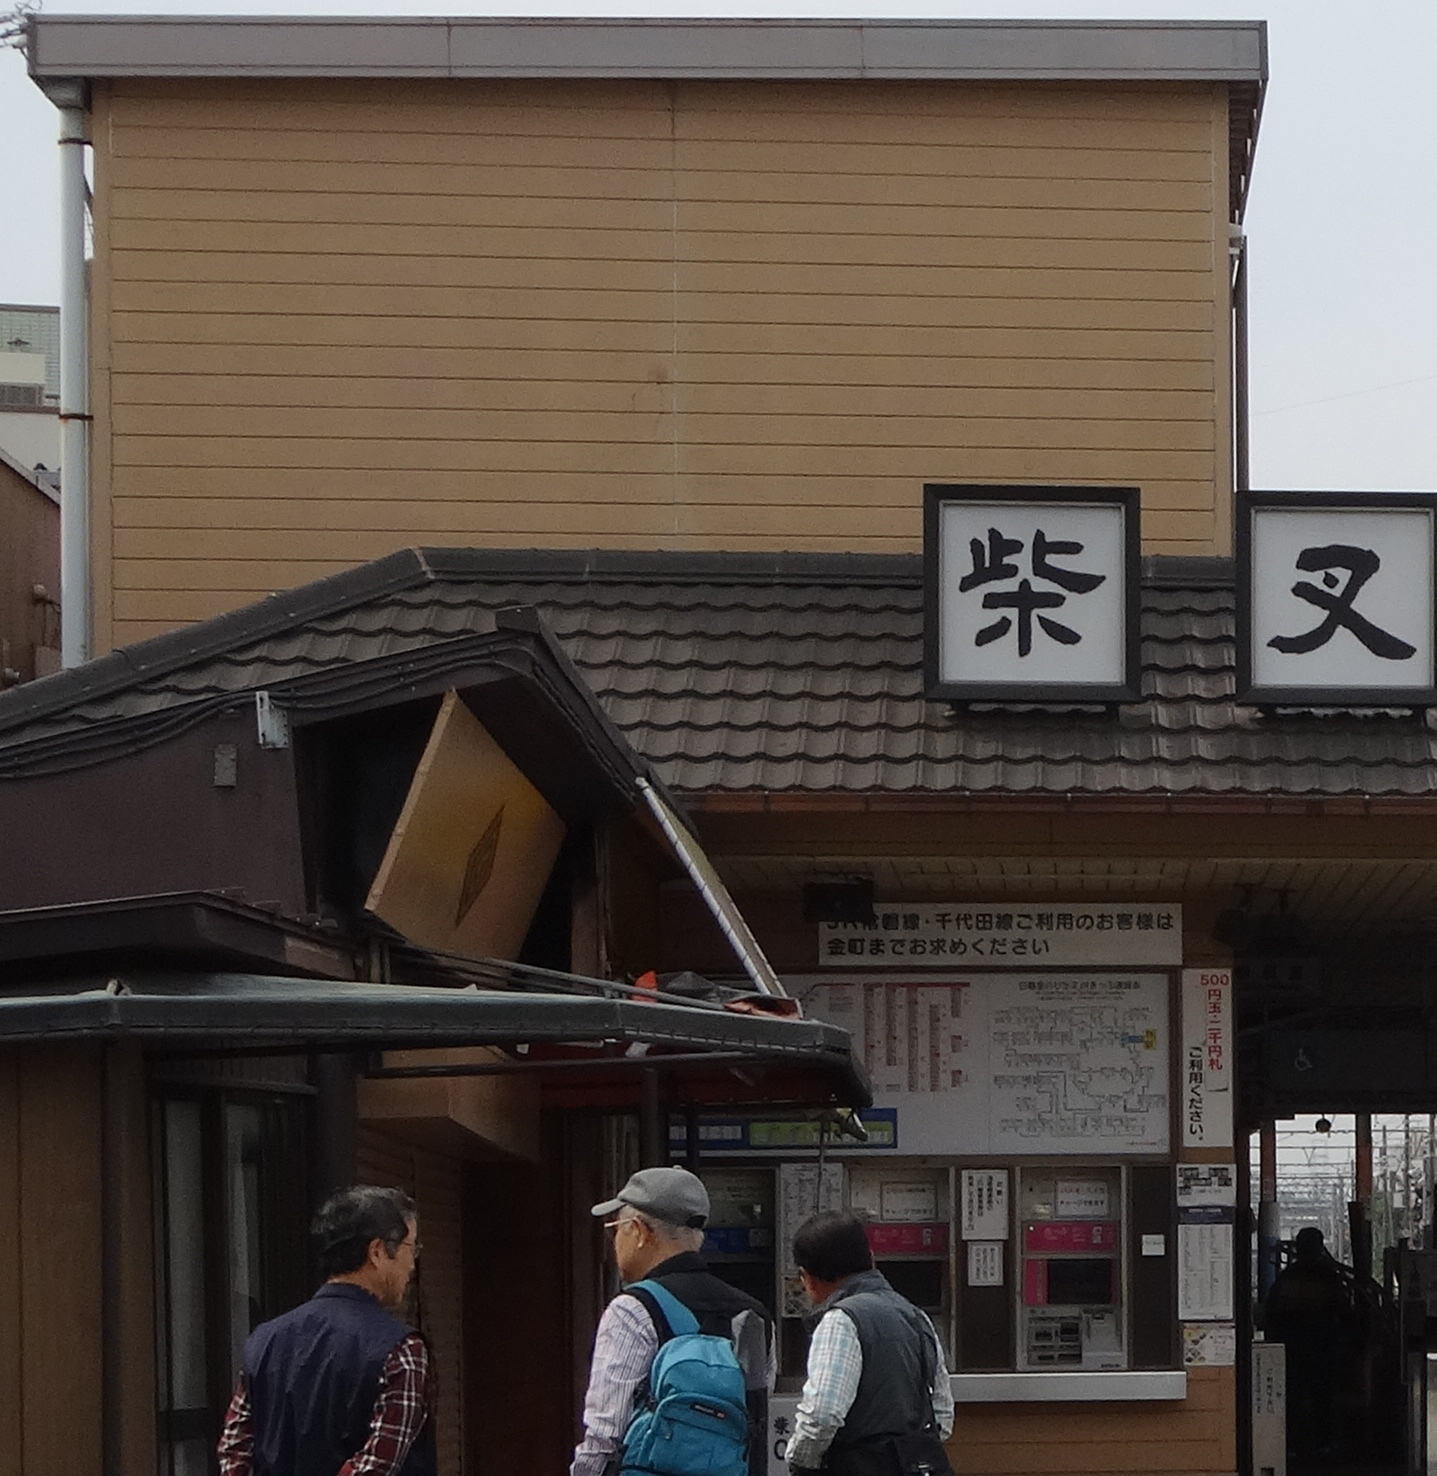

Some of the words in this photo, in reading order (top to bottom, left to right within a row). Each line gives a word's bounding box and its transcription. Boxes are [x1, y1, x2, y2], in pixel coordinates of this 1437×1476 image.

[827, 937, 1049, 956] 金町までお求めください
